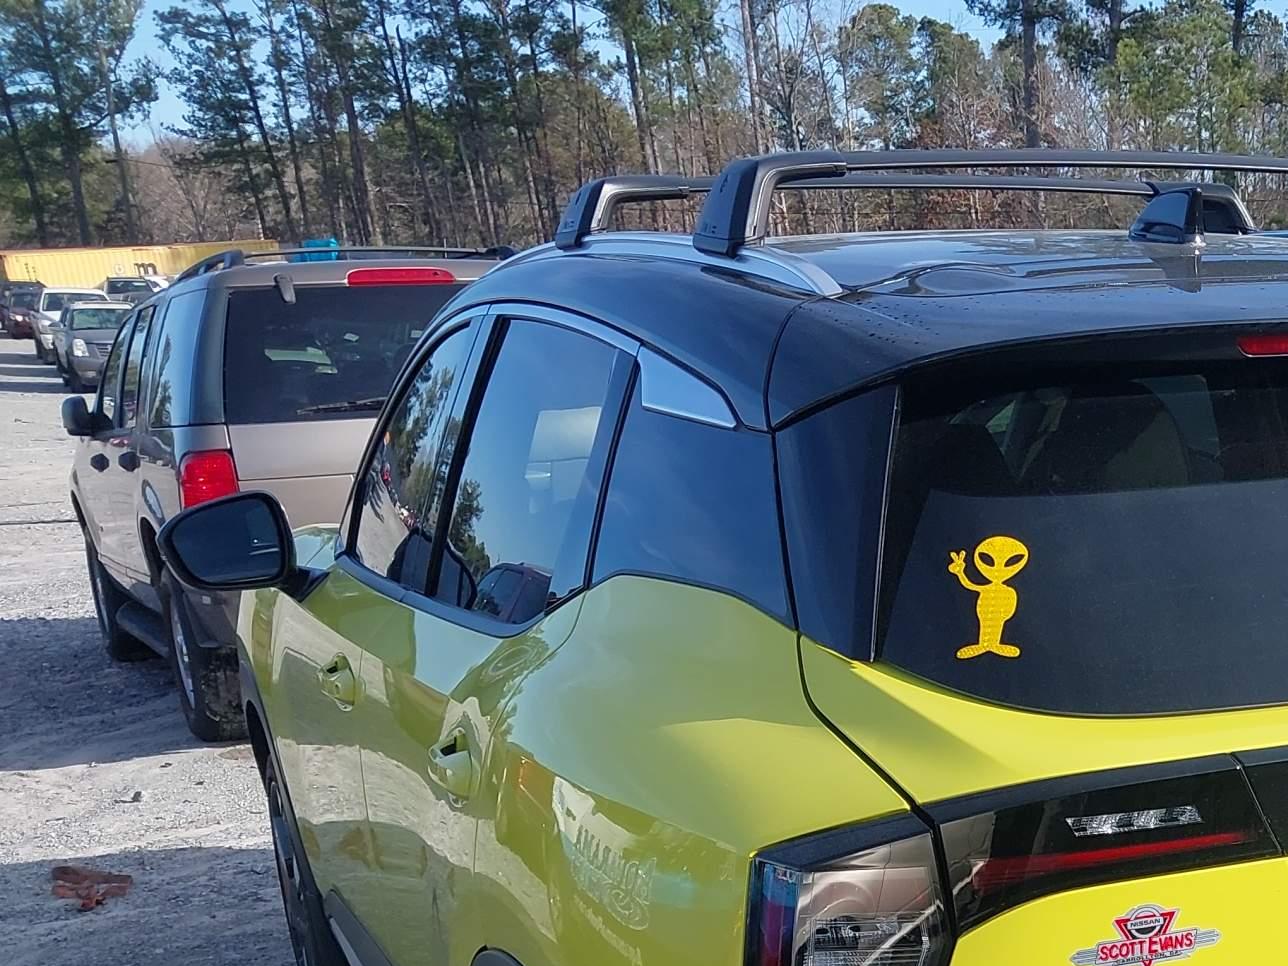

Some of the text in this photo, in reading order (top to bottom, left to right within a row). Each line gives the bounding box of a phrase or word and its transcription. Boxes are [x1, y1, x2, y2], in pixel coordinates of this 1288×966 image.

[1130, 917, 1161, 928] NISSAN
[1099, 932, 1193, 961] SCOTT EVANS
